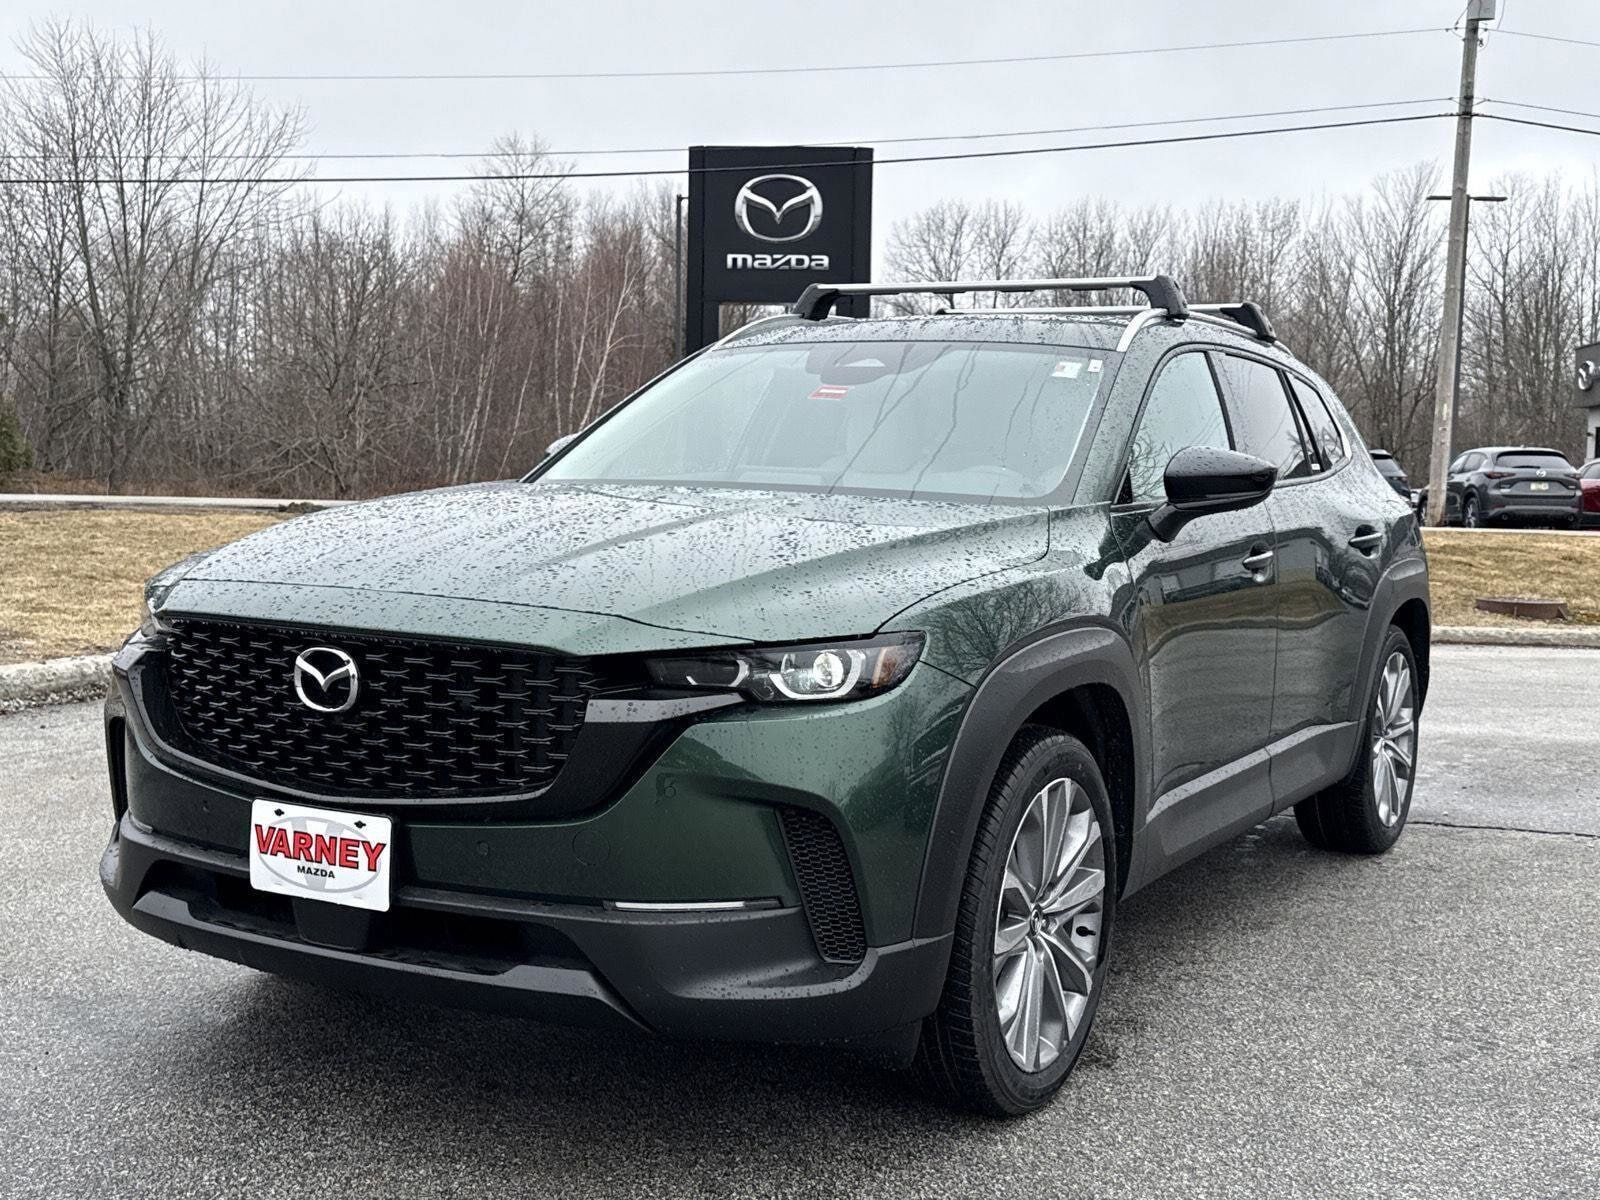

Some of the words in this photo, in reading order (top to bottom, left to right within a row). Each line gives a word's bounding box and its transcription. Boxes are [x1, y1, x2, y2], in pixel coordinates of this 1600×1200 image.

[726, 253, 829, 270] mazda
[255, 824, 387, 872] VARNEY
[297, 865, 335, 879] MAZDA
